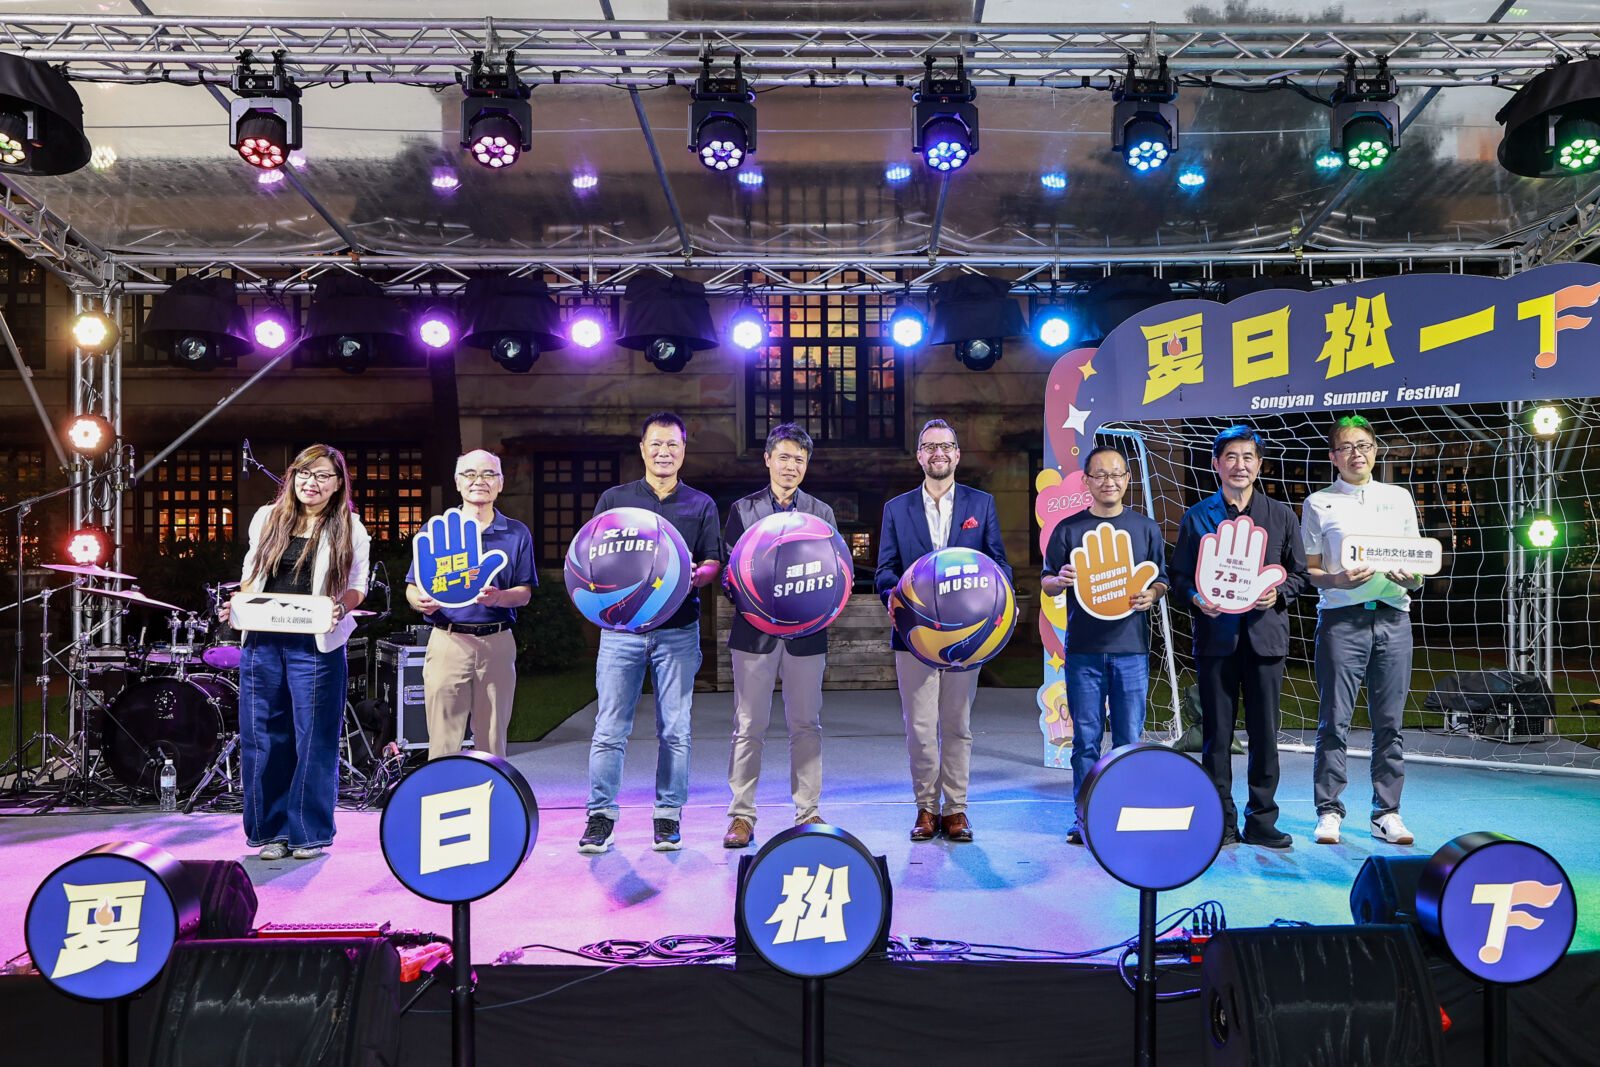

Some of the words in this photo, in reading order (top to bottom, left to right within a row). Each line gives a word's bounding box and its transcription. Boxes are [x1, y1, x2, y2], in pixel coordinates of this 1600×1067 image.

[1140, 282, 1600, 405] 夏日松一下
[1251, 394, 1314, 410] Songyan
[1323, 389, 1389, 407] Summer
[1397, 383, 1461, 402] Festival
[1047, 491, 1094, 512] 2026
[602, 527, 640, 539] 文化
[589, 539, 654, 560] CULTURE
[1366, 547, 1433, 559] 台北市文化基金會
[435, 552, 468, 577] 夏日
[1089, 565, 1128, 583] Songyan
[773, 574, 834, 598] SPORTS
[939, 576, 989, 595] MUSIC
[1090, 577, 1128, 594] Summer
[1214, 570, 1238, 583] 7.3
[1092, 588, 1127, 605] Festival
[1211, 587, 1235, 600] 9.6
[420, 778, 495, 875] 日
[1115, 805, 1196, 832] 一
[764, 862, 852, 945] 松
[50, 879, 147, 980] 夏
